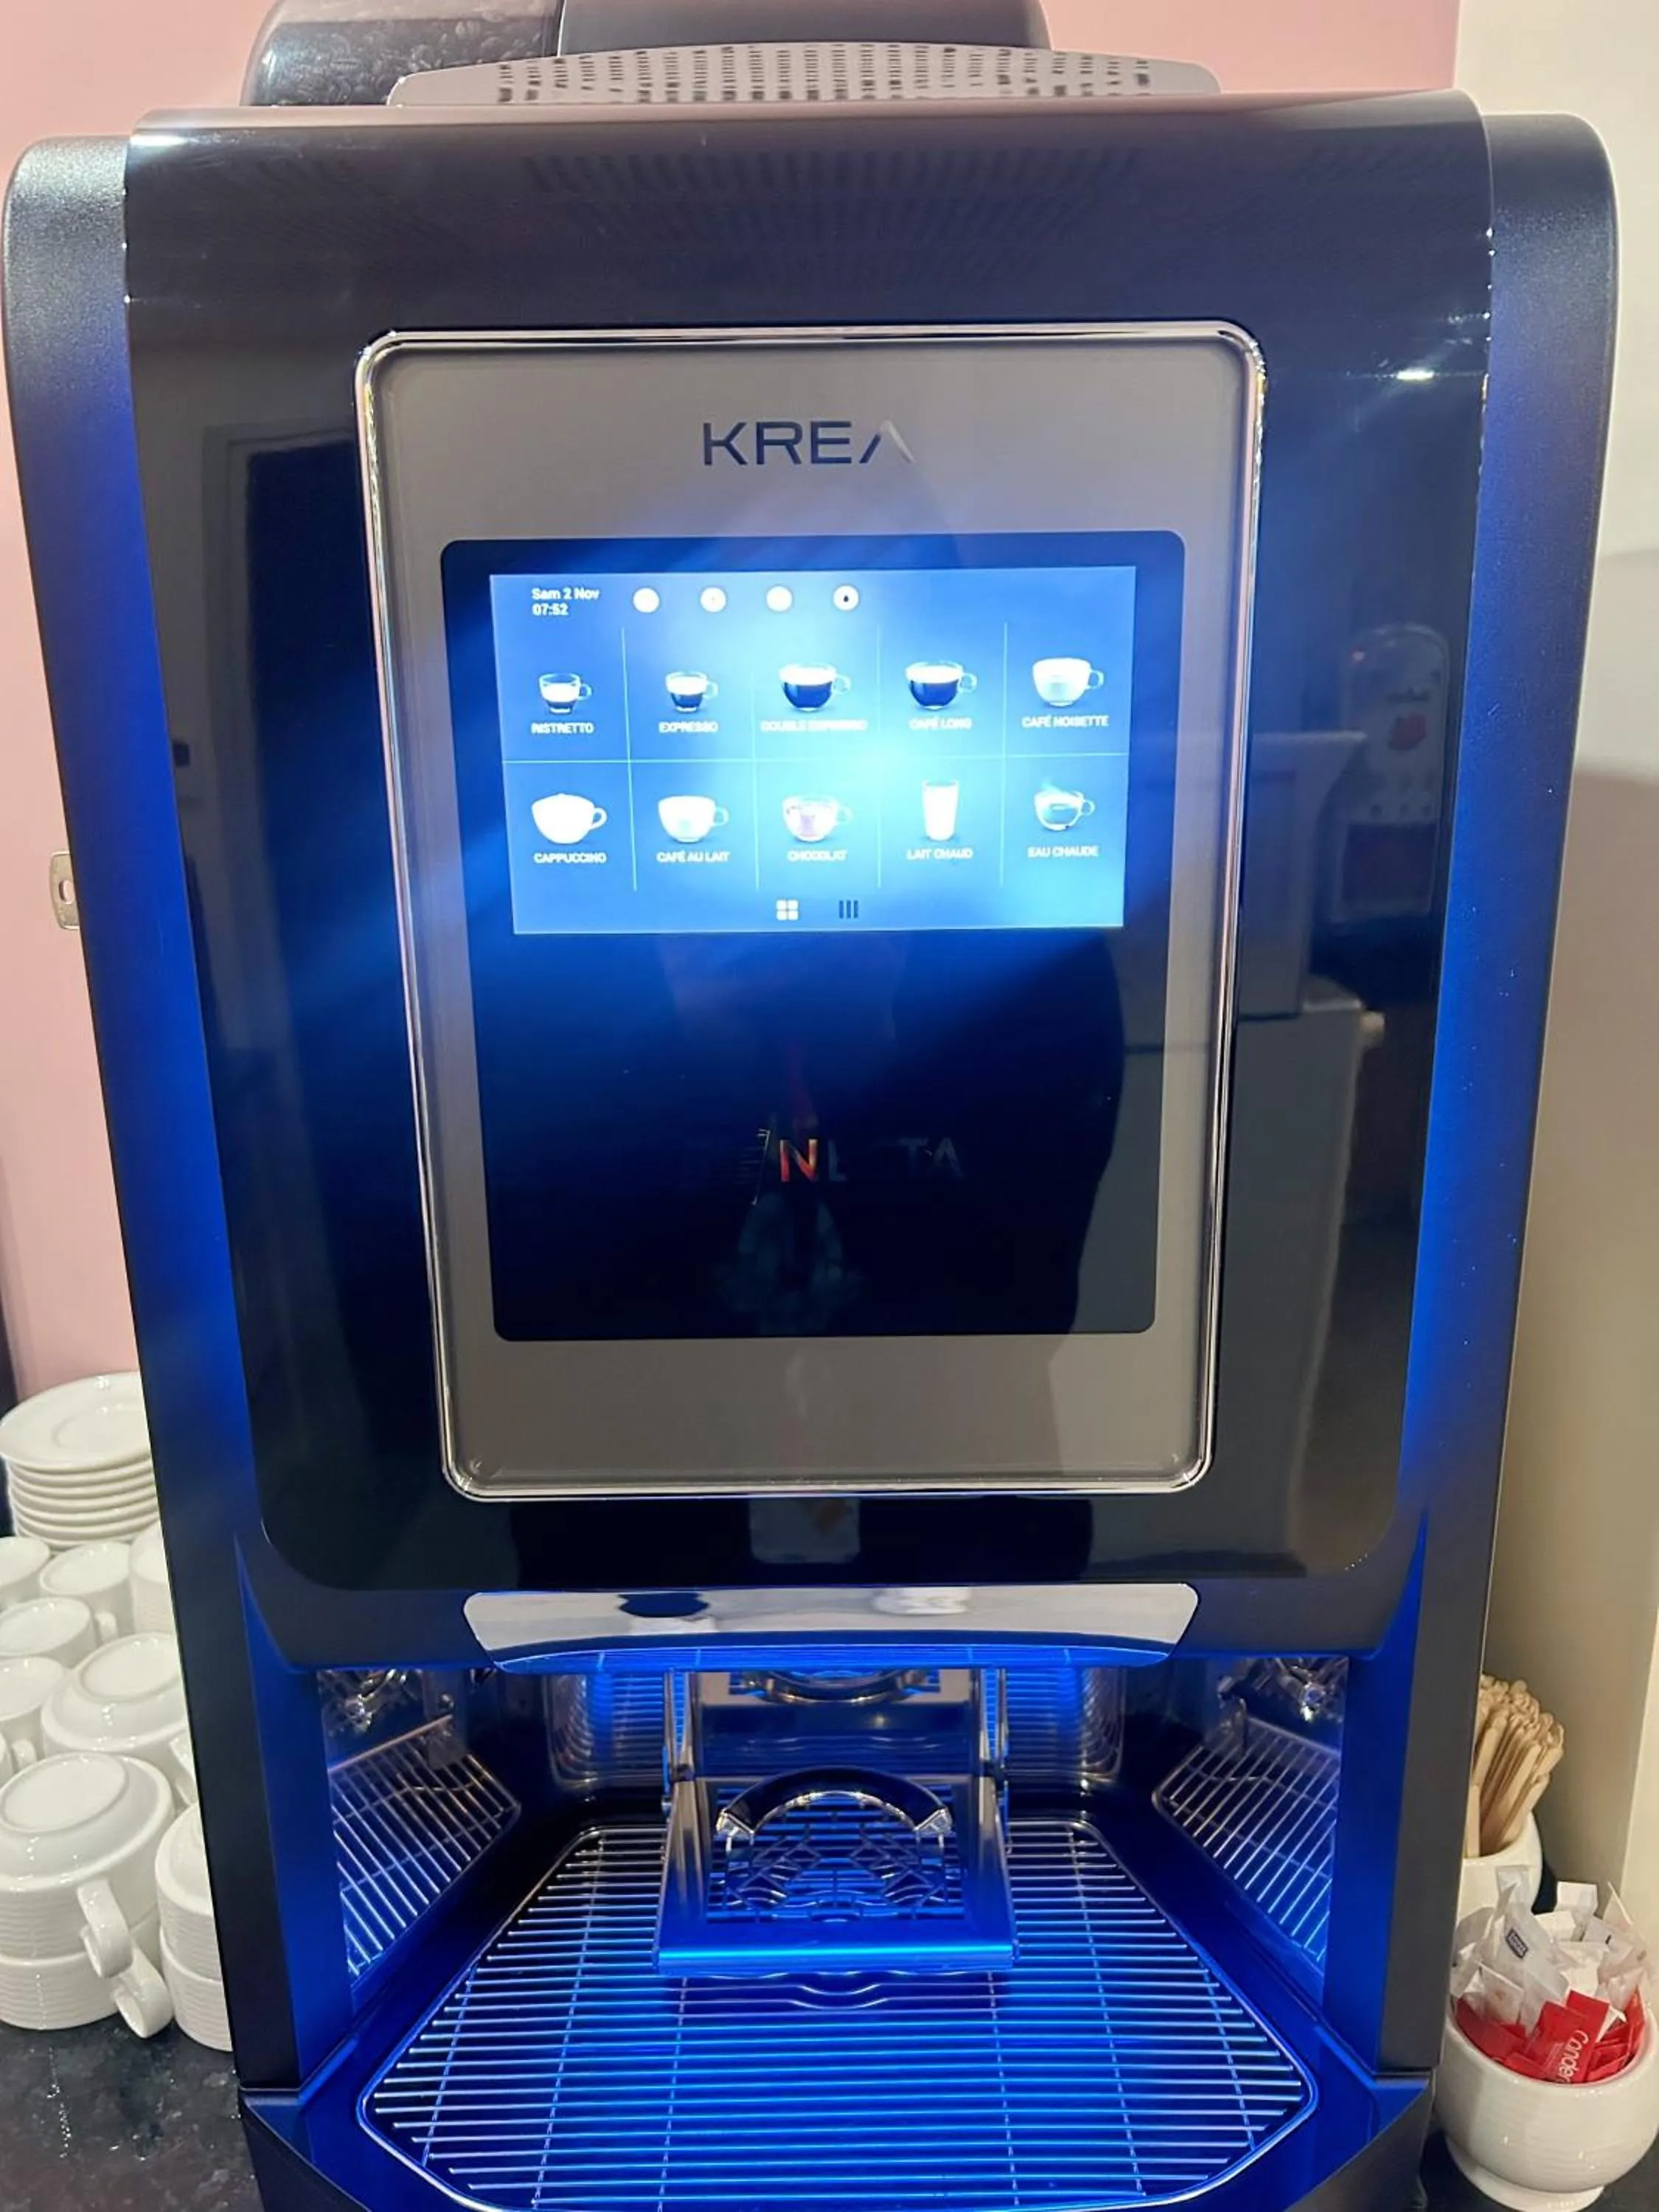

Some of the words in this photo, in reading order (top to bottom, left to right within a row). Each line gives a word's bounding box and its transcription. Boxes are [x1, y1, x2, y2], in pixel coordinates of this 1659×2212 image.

[532, 588, 560, 599] Sam
[563, 588, 572, 599] 2
[574, 587, 599, 599] Nov
[532, 603, 568, 615] 07:52
[531, 723, 594, 734] RISTRETTO
[534, 852, 606, 863] CAPPUCCINO
[657, 851, 686, 863] CAFÉ
[687, 852, 703, 862] AU
[705, 851, 729, 862] LAIT
[907, 848, 932, 860] LAIT
[1028, 846, 1051, 857] EAU
[1052, 846, 1098, 857] CHAUDE
